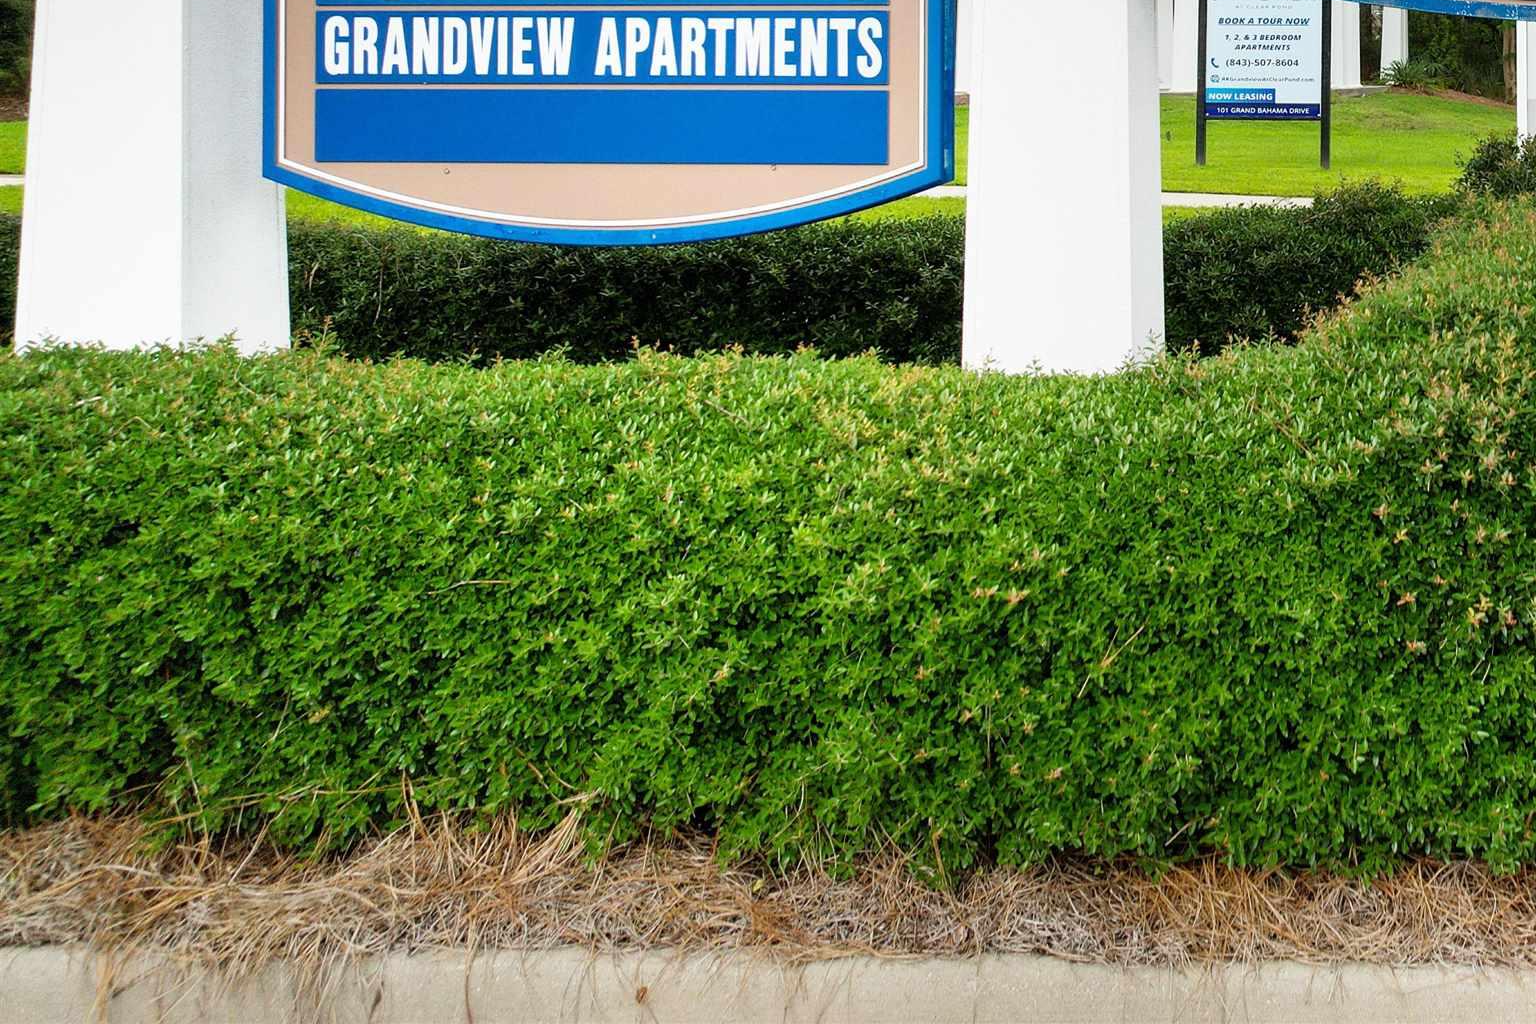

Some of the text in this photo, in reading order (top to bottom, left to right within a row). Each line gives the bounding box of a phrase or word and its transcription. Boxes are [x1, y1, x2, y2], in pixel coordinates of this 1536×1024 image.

[1218, 17, 1245, 25] BOOK
[1258, 17, 1283, 25] TOUR
[1285, 17, 1310, 25] NOW
[323, 15, 884, 78] GRANDVIEW APARTMENTS
[1225, 58, 1299, 67] (843)-507-8604
[1234, 93, 1273, 101] LEASING
